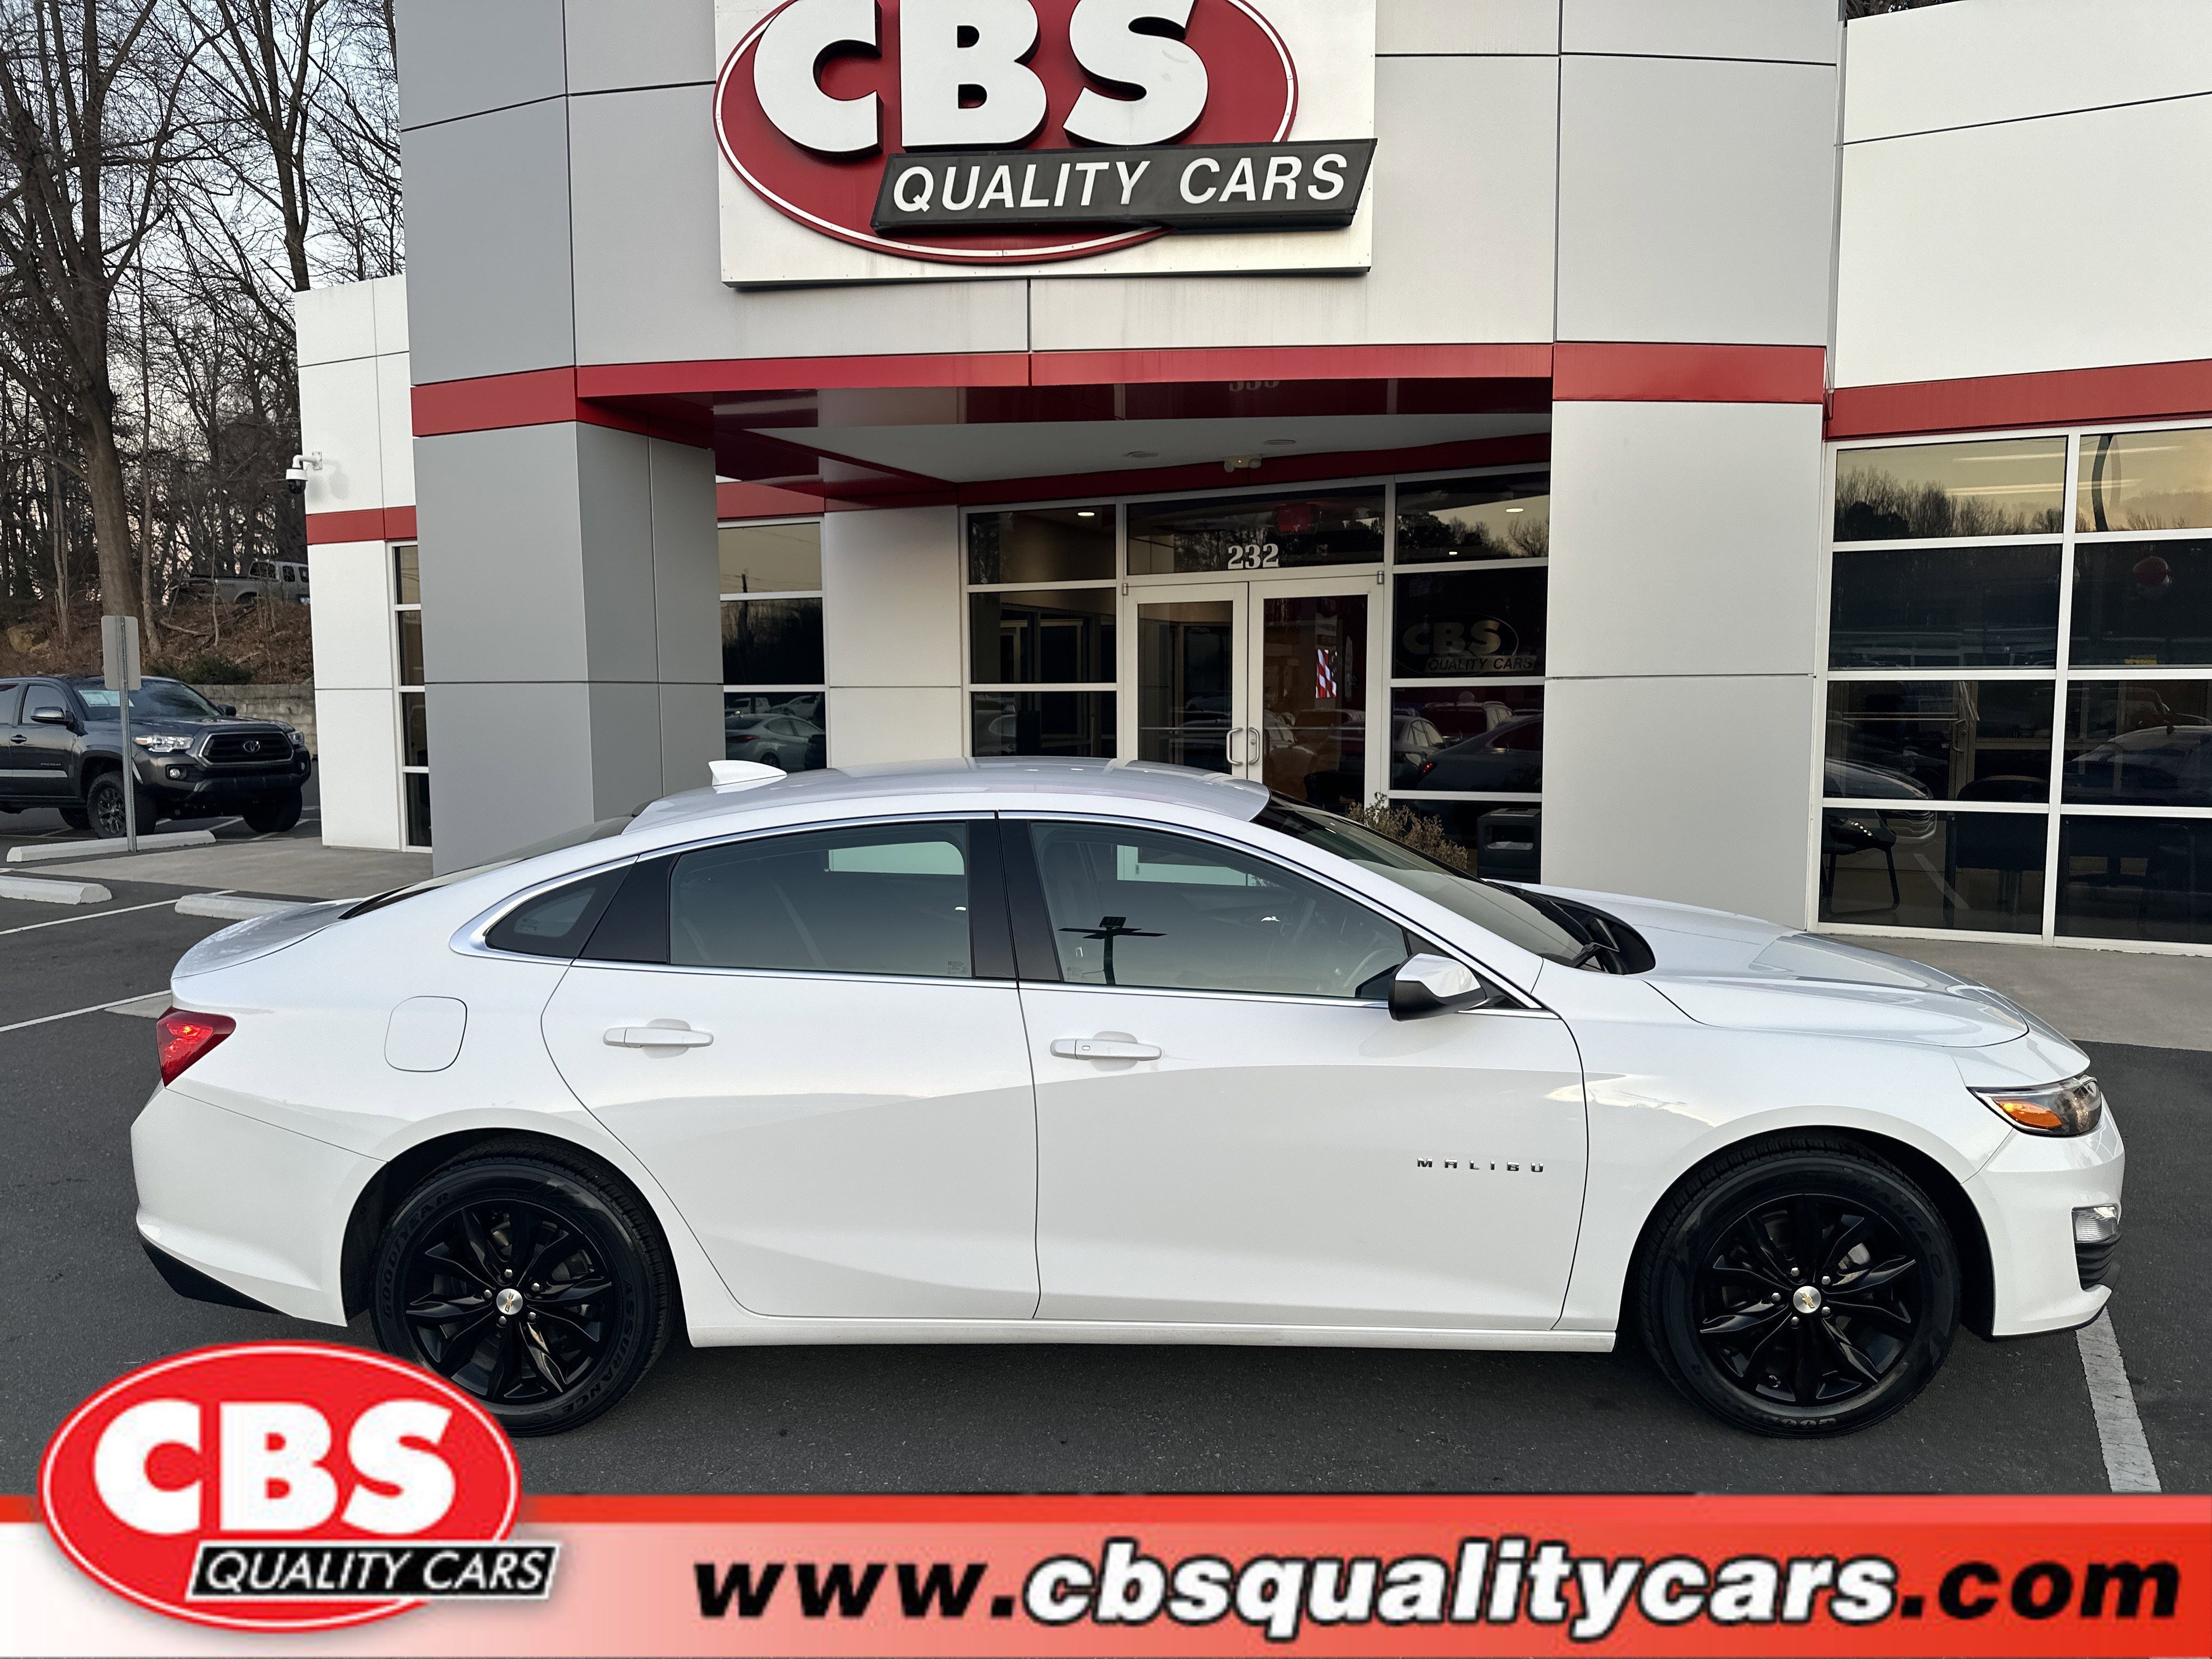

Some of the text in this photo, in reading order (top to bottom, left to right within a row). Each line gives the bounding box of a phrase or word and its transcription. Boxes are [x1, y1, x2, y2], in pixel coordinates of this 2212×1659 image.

[753, 0, 1209, 152] CBS
[893, 153, 1348, 213] QUALITY CARS
[1227, 543, 1279, 570] 232
[1402, 619, 1501, 654] CBS
[1427, 658, 1533, 671] QUALITY CARS
[1417, 1157, 1544, 1172] MALIBU
